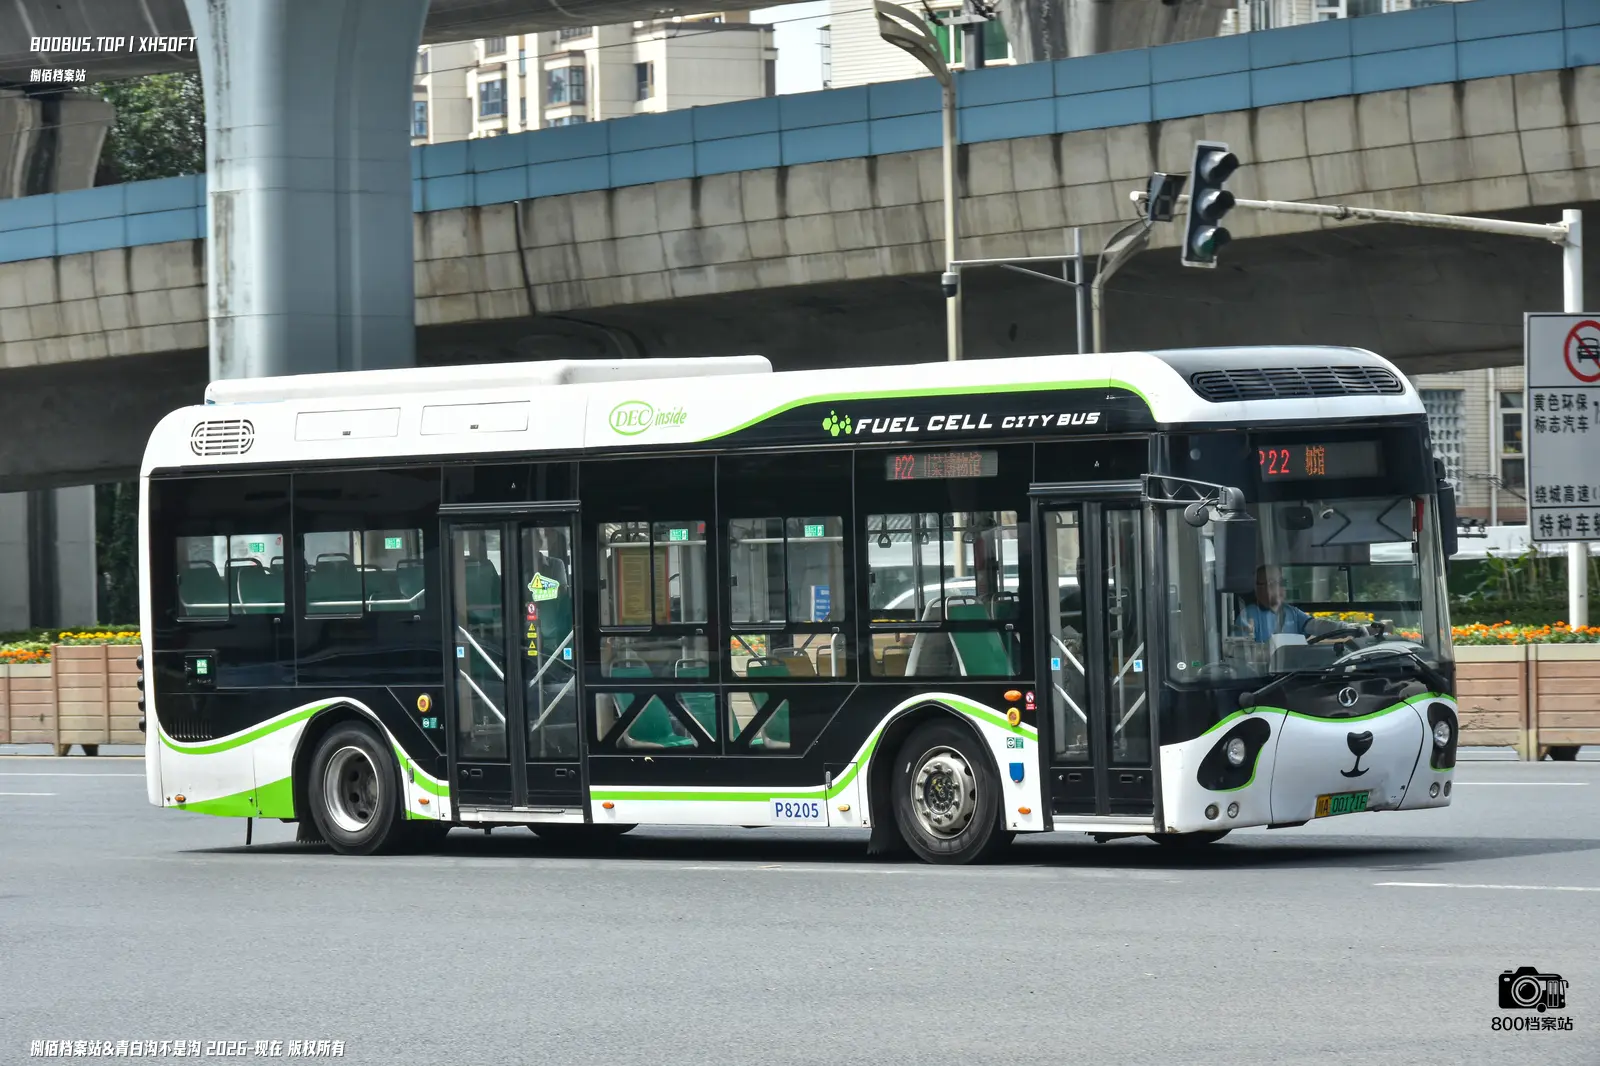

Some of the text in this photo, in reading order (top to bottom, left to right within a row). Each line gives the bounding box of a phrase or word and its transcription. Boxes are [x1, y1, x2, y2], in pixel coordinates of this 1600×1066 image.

[1533, 393, 1588, 412] 黄色环保
[615, 406, 688, 427] DEC inside
[855, 411, 1101, 435] FUEL CELL CITY BUS
[1534, 415, 1590, 434] 标志汽车
[895, 454, 915, 480] P22
[775, 802, 819, 818] P8205
